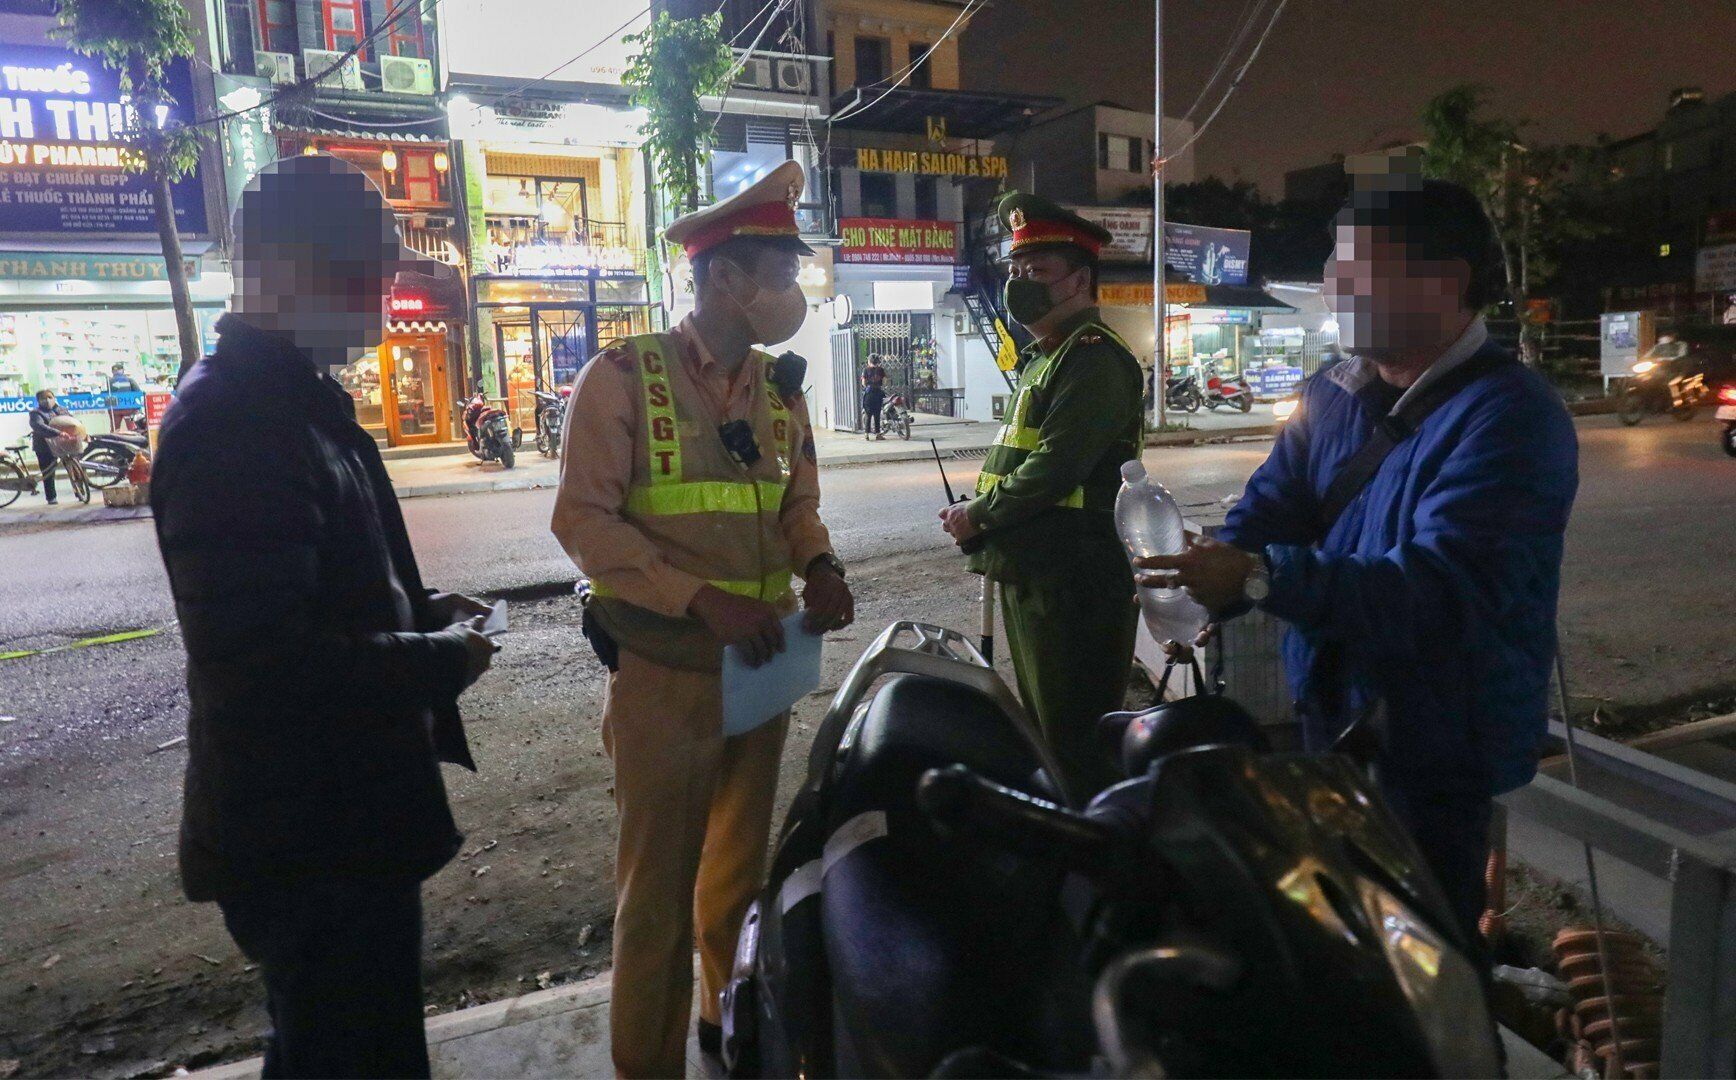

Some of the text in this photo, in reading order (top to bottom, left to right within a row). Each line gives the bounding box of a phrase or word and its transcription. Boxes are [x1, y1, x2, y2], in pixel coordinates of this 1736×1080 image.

[3, 62, 91, 94] THUỐC
[857, 148, 1008, 178] HA HAIR SALON & SPA
[100, 174, 129, 186] GPP
[15, 188, 63, 204] THUỐC
[843, 222, 954, 252] CHO THUÊ MẶT BẰNG
[643, 351, 675, 476] CSGT
